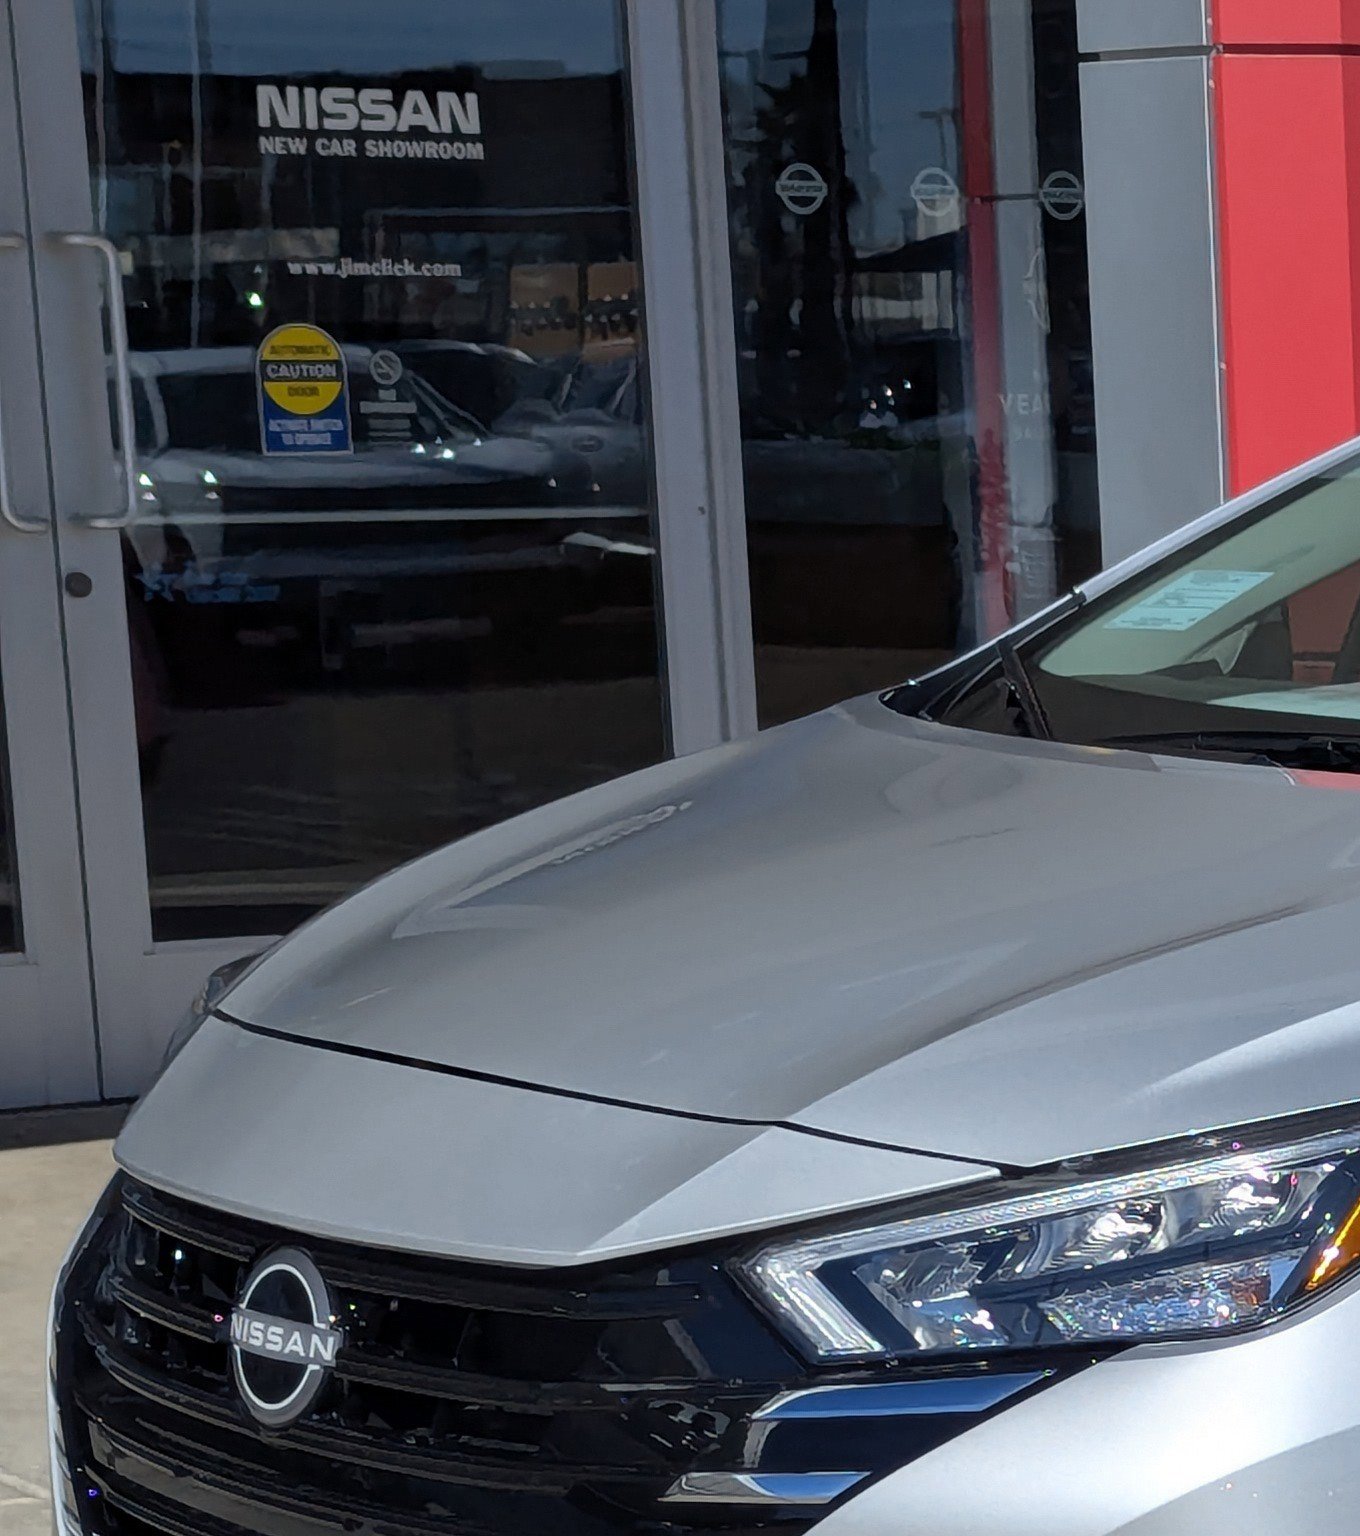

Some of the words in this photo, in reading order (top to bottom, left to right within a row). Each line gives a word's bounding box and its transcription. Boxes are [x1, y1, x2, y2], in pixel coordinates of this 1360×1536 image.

[256, 84, 481, 134] NISSAN
[259, 136, 307, 155] NEW
[315, 138, 357, 157] CAR
[364, 139, 484, 160] SHOWROOM
[287, 257, 462, 278] www.jimclick.com
[266, 363, 336, 378] CAUTION
[230, 1313, 335, 1361] NISSAN
